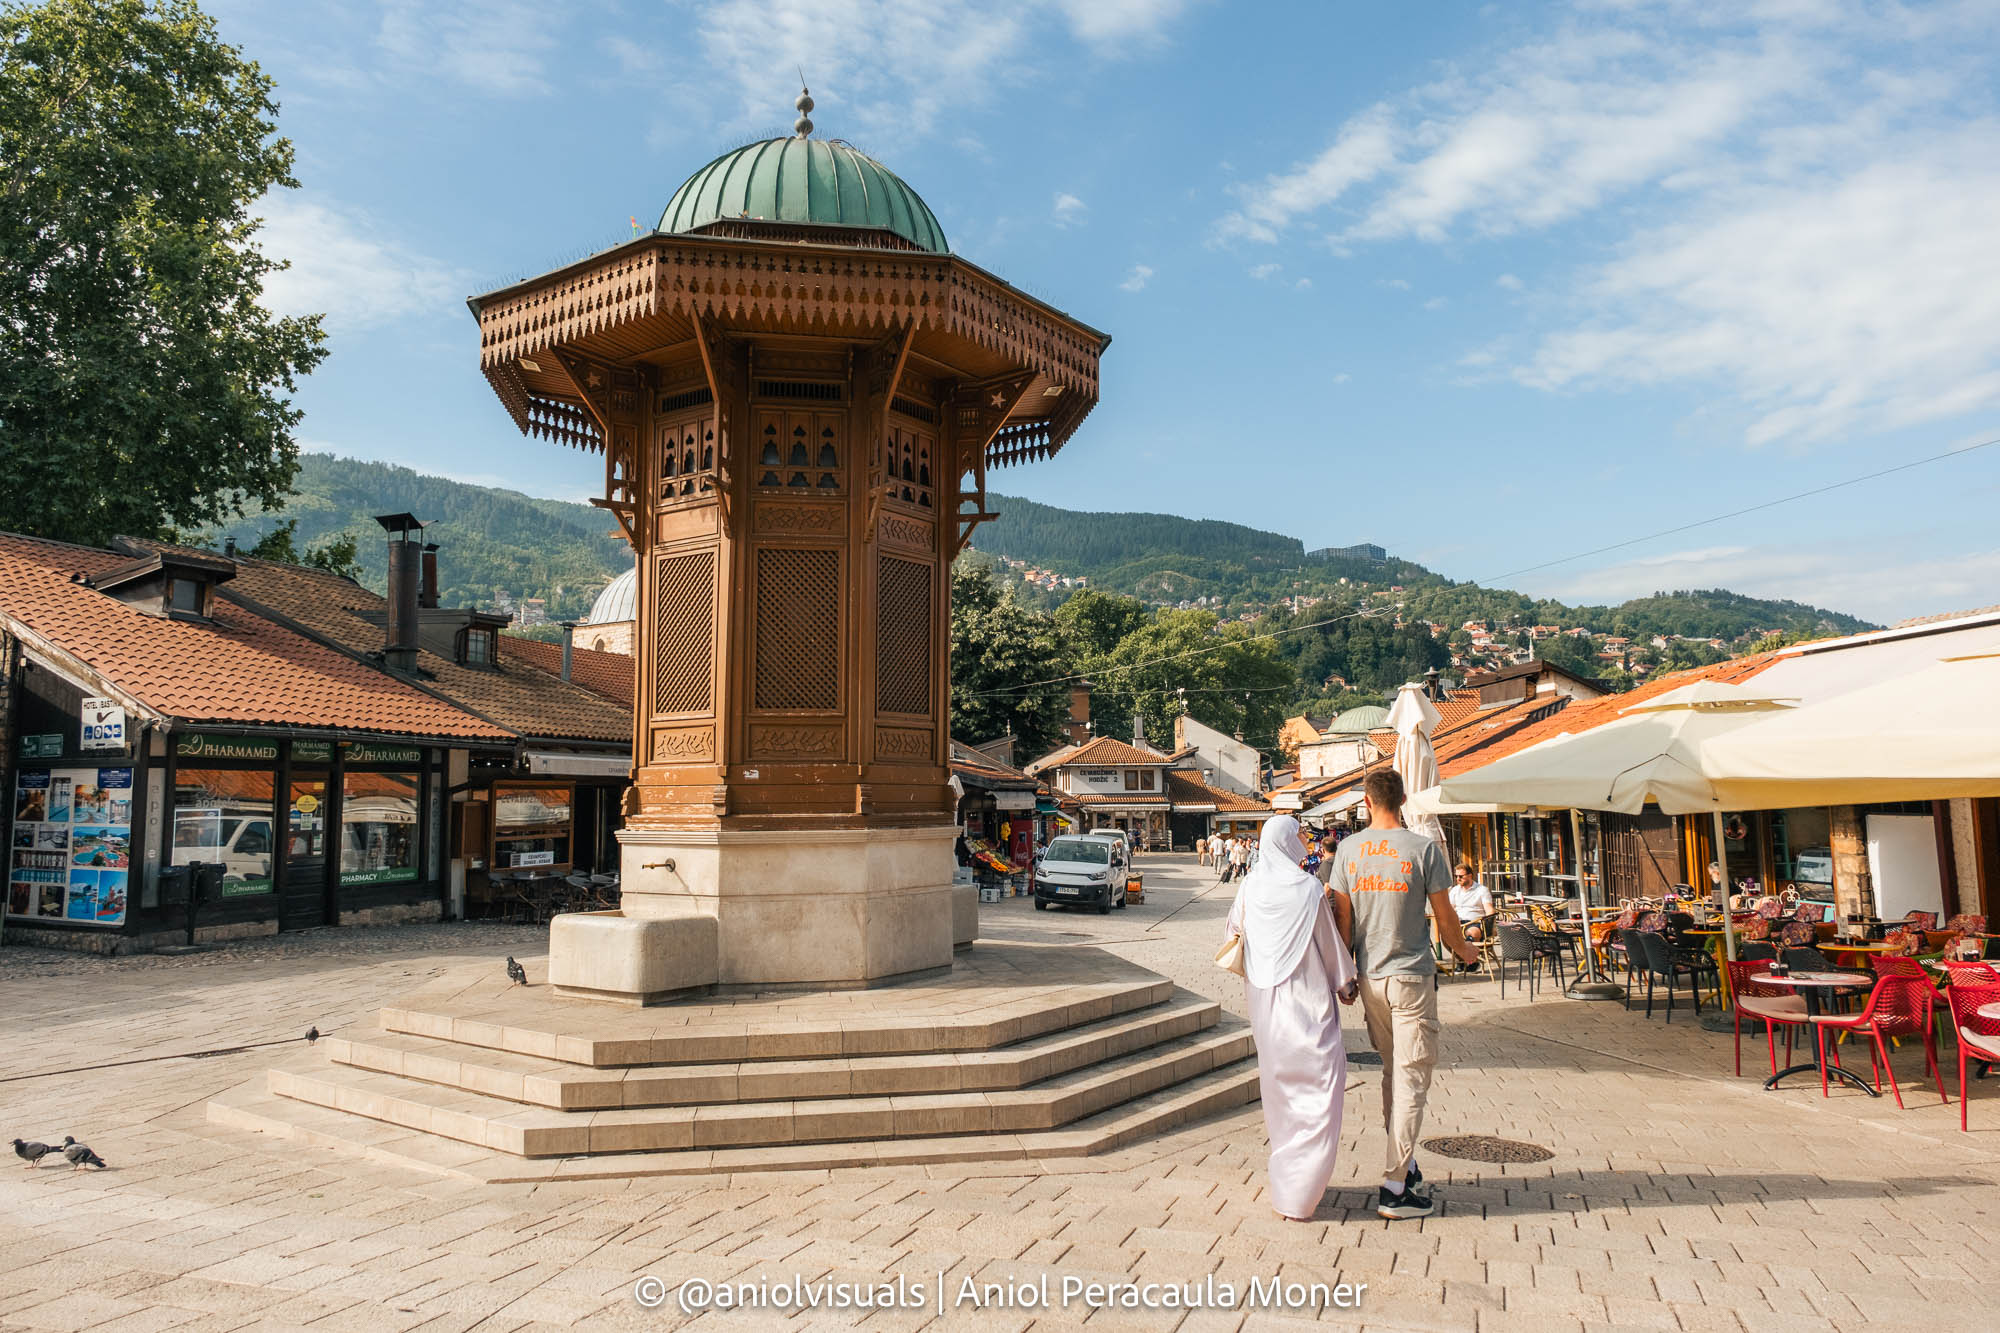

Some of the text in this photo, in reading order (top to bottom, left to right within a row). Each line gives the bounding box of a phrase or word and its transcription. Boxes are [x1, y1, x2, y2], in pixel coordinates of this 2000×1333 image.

[83, 701, 98, 710] HOTEL
[204, 743, 277, 759] PHARMAMED
[364, 750, 421, 761] PHARMAMED
[1360, 839, 1400, 859] Nike
[1400, 861, 1413, 875] 72
[341, 873, 378, 883] PHARMACY
[1351, 874, 1409, 893] Athletics
